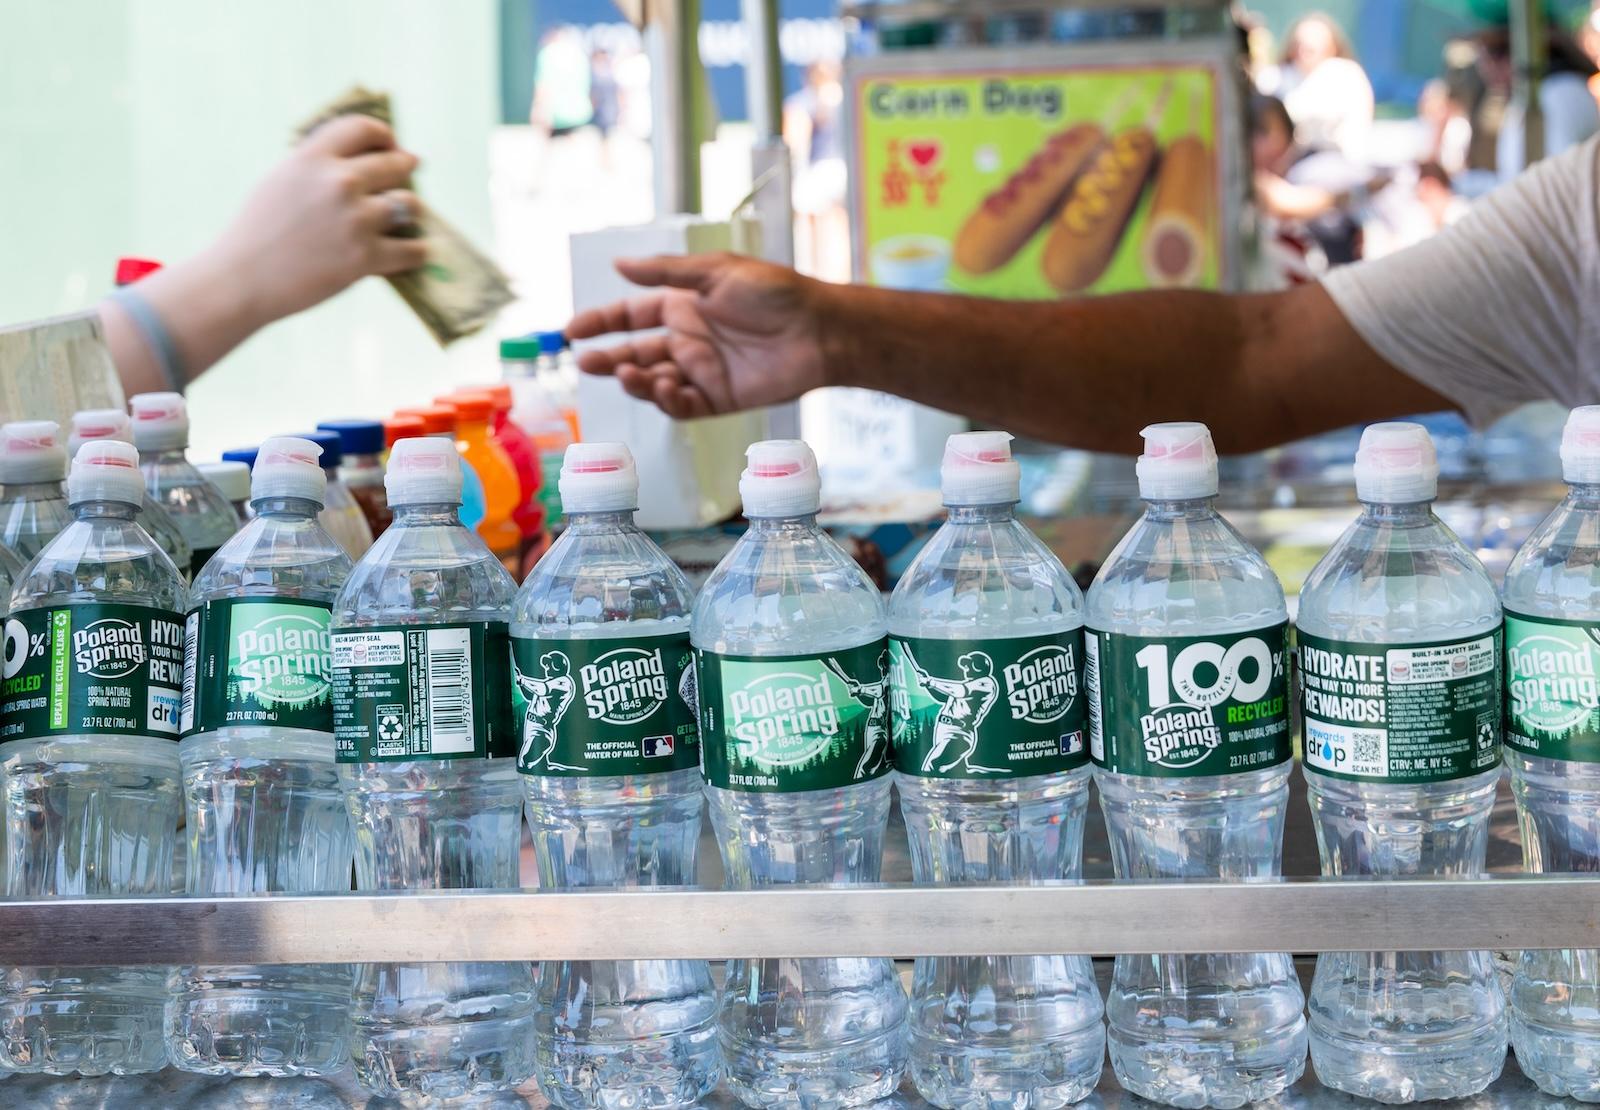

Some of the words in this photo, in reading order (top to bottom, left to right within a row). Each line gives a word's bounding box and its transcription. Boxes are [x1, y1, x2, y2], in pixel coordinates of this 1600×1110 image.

[982, 80, 1063, 118] Dog
[57, 629, 65, 656] PLEASE
[73, 622, 143, 655] Poland
[238, 622, 332, 664] Poland
[75, 642, 144, 673] Spring
[151, 644, 171, 659] YOUR
[1412, 650, 1441, 658] BUILT-IN
[1443, 646, 1467, 655] SAFETY
[1468, 643, 1481, 651] SEAL
[1509, 641, 1594, 681] Poland
[110, 661, 128, 670] 1845
[239, 650, 333, 693] Spring
[460, 657, 469, 688] 43115
[579, 648, 665, 695] Poland
[1003, 643, 1076, 695] Poland
[1135, 636, 1284, 708] 100%
[1303, 645, 1385, 682] HYDRATE
[55, 682, 63, 697] THE
[88, 686, 104, 696] 100%
[105, 687, 132, 697] NATURAL
[281, 675, 306, 686] 1845
[1180, 679, 1194, 698] THIS
[1196, 685, 1227, 702] BOTTLE
[1305, 673, 1322, 688] YOUR
[1322, 678, 1341, 694] WAY
[1341, 682, 1354, 695] TO
[1355, 683, 1385, 697] MORE
[88, 697, 108, 707] SPRING
[109, 697, 131, 708] WATER
[584, 675, 668, 719] Spring
[620, 698, 642, 711] 1845
[729, 671, 834, 726] Poland
[1008, 670, 1078, 720] Spring
[1041, 696, 1060, 710] 1845
[1305, 688, 1386, 723] REWARDS!
[1511, 673, 1600, 715] Spring
[54, 699, 63, 725] REPEAT
[253, 711, 267, 721] (700
[462, 693, 471, 723] 75720
[609, 712, 625, 721] MAINE
[626, 708, 644, 720] SPRING
[1539, 701, 1561, 712] 1845
[82, 717, 95, 728] 23.7
[96, 717, 103, 728] FL
[104, 717, 112, 728] OZ
[113, 717, 126, 729] (700
[735, 705, 839, 757] Spring
[1140, 703, 1215, 741] Poland
[1244, 727, 1265, 740] NATURAL
[586, 742, 602, 750] THE
[603, 741, 637, 749] OFFICIAL
[777, 735, 803, 749] 1845
[1025, 739, 1056, 749] OFFICIAL
[1144, 726, 1218, 762] Spring
[1308, 727, 1345, 743] rewards
[584, 750, 611, 760] WATER
[612, 750, 622, 759] OF
[623, 749, 640, 758] MLB
[1007, 751, 1032, 760] WATER
[1033, 750, 1043, 758] OF
[1044, 748, 1058, 757] MLB
[1181, 748, 1199, 758] 1845
[1430, 758, 1440, 768] NY
[1352, 765, 1369, 773] SCAN
[1370, 765, 1384, 774] ME!
